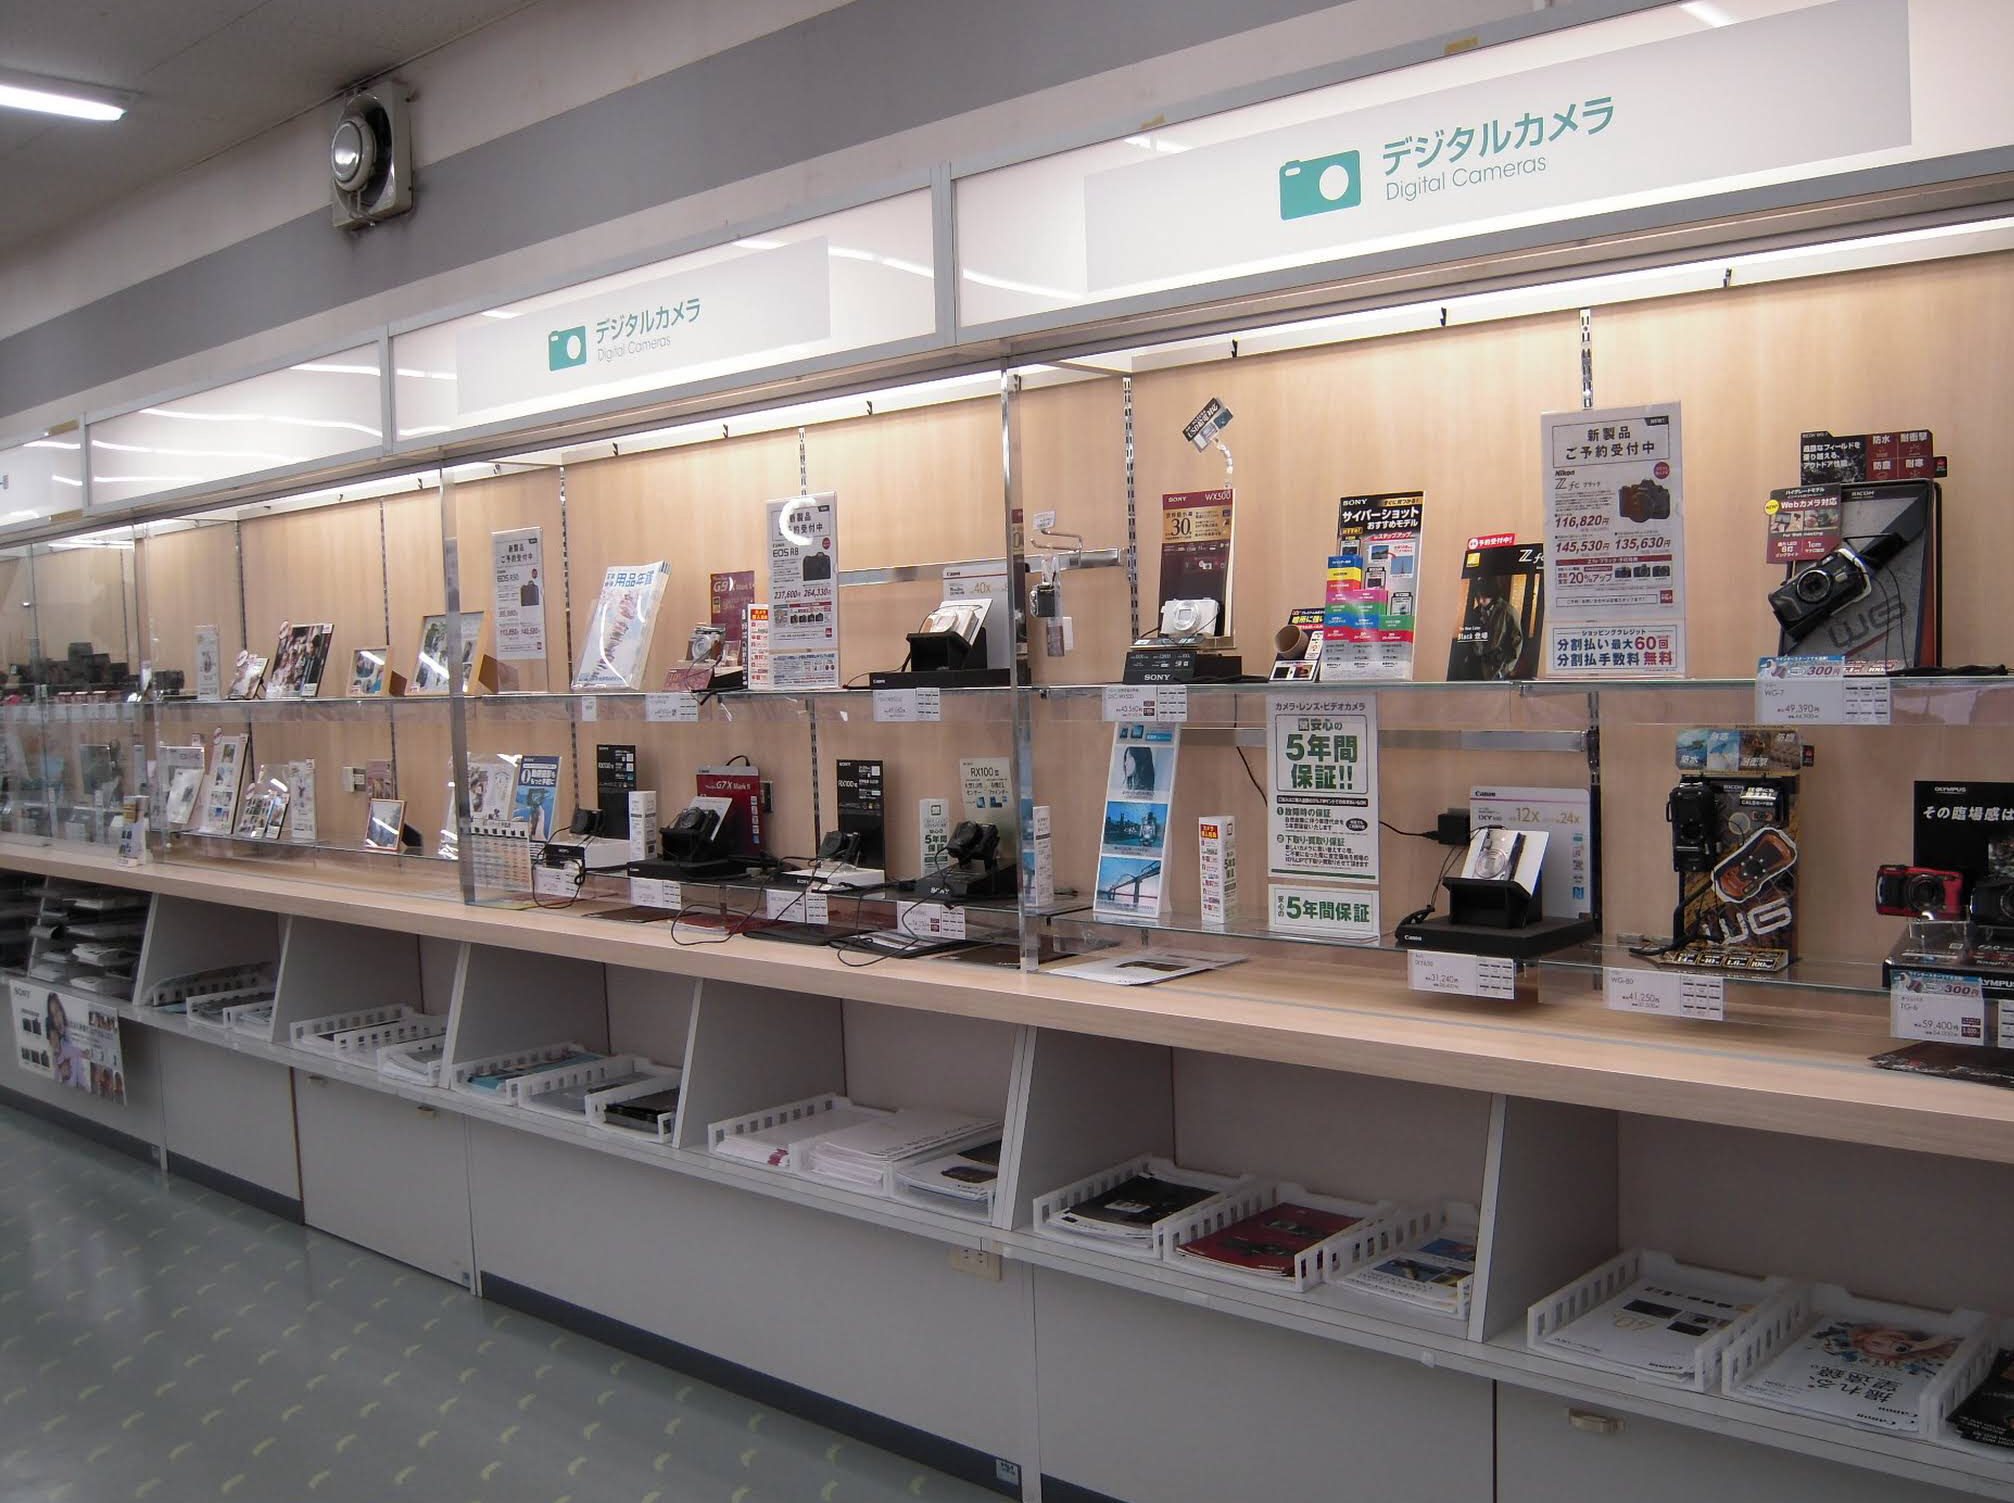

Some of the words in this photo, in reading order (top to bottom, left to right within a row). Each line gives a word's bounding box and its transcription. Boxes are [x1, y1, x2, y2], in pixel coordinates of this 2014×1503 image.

[1382, 97, 1614, 175] デジタルカメラ
[1386, 171, 1445, 201] Digital
[1453, 154, 1547, 188] Cameras
[596, 298, 701, 344] デジタルカメラ
[597, 343, 627, 362] Digital
[628, 335, 671, 354] Cameras
[1587, 426, 1631, 442] 新製品
[1872, 434, 1891, 445] 防水
[1566, 441, 1655, 460] ご予約受付中
[1781, 497, 1837, 509] Webカメラ対応
[1342, 507, 1419, 522] サイバーショット
[1367, 519, 1418, 530] おすすめモデル
[1615, 537, 1671, 551] 135,630円
[773, 549, 788, 557] EOS
[1276, 702, 1366, 711] カメラ・レンズ・ビデオカメラ
[1286, 733, 1357, 763] 5年間
[1291, 764, 1352, 791] 保証!!
[1923, 806, 2014, 821] その臨場感は
[1287, 896, 1371, 923] 5年間保証
